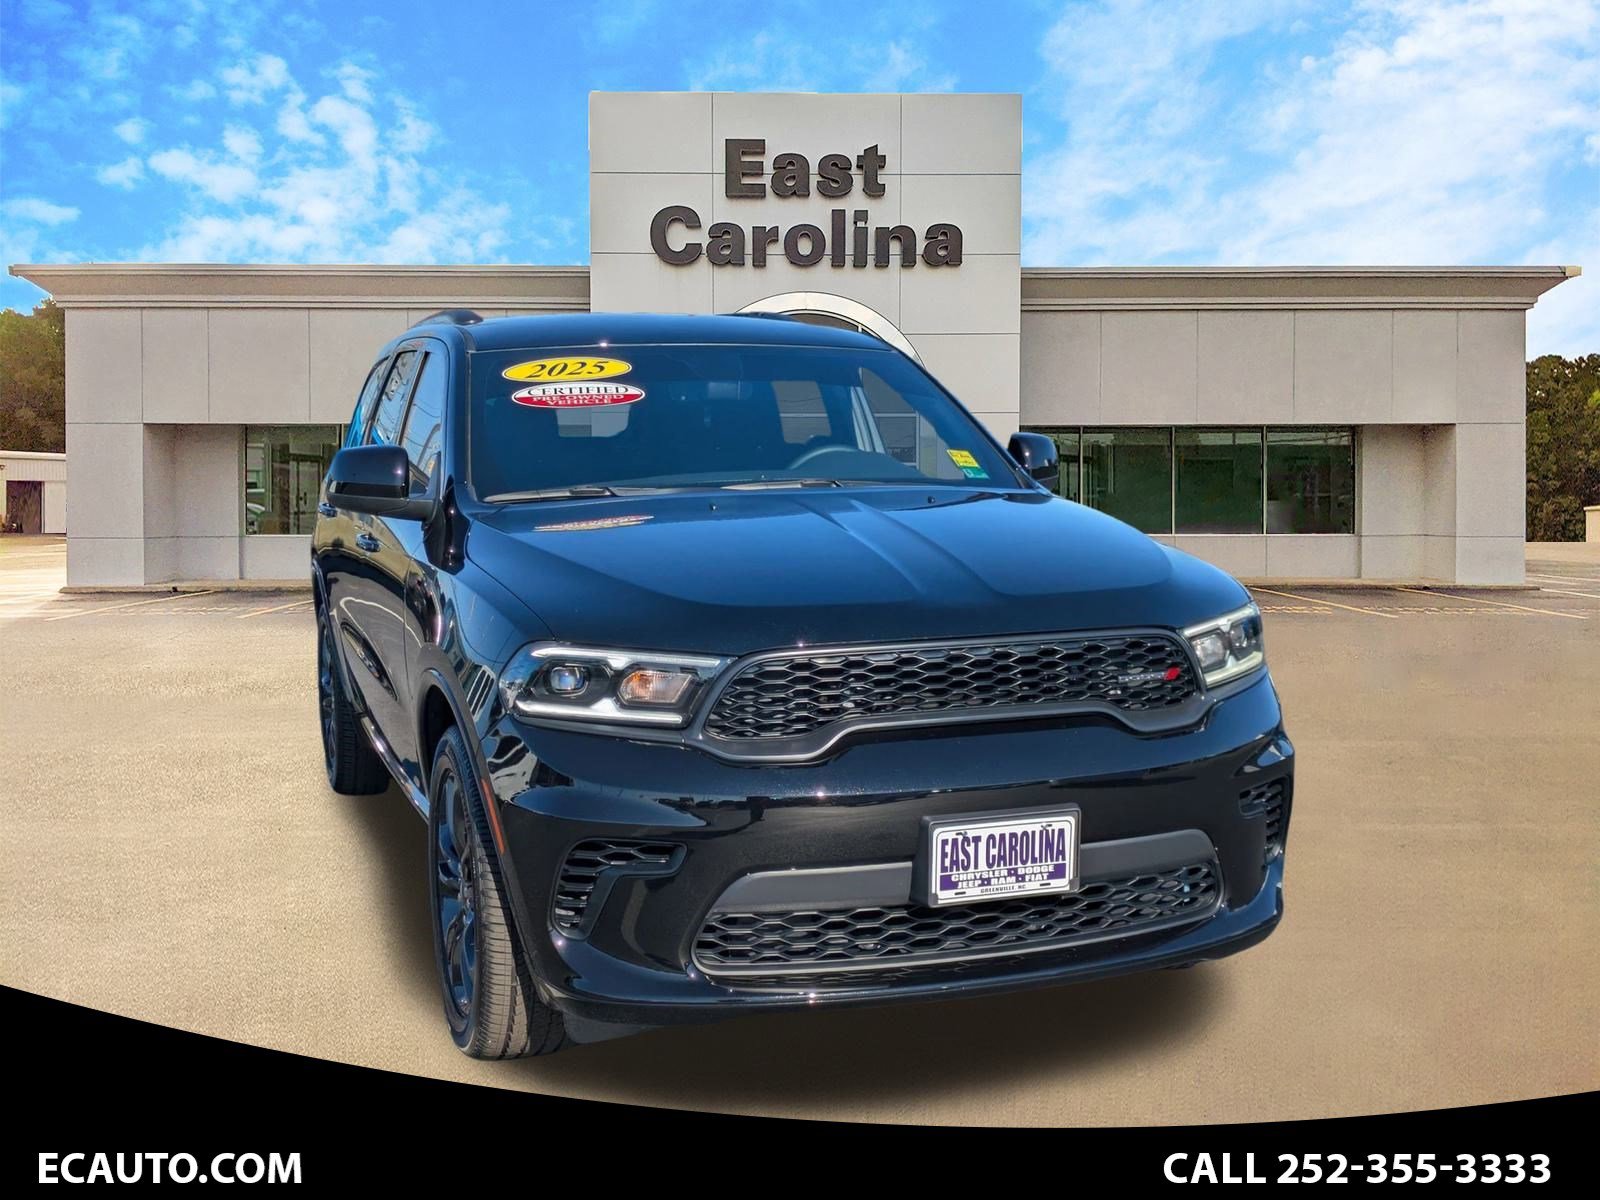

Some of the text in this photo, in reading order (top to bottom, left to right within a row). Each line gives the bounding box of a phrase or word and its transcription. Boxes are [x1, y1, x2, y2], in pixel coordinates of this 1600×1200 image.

[725, 138, 887, 200] East
[650, 205, 963, 268] Carolina
[525, 361, 609, 378] 2025
[527, 386, 629, 397] CERTIFIED
[532, 394, 625, 402] PRE-OWNED
[940, 828, 1067, 873] EAST CAROLINA
[951, 864, 1055, 882] CHRYSLER DODGE
[957, 873, 1049, 889] JEEP RAM FIAT
